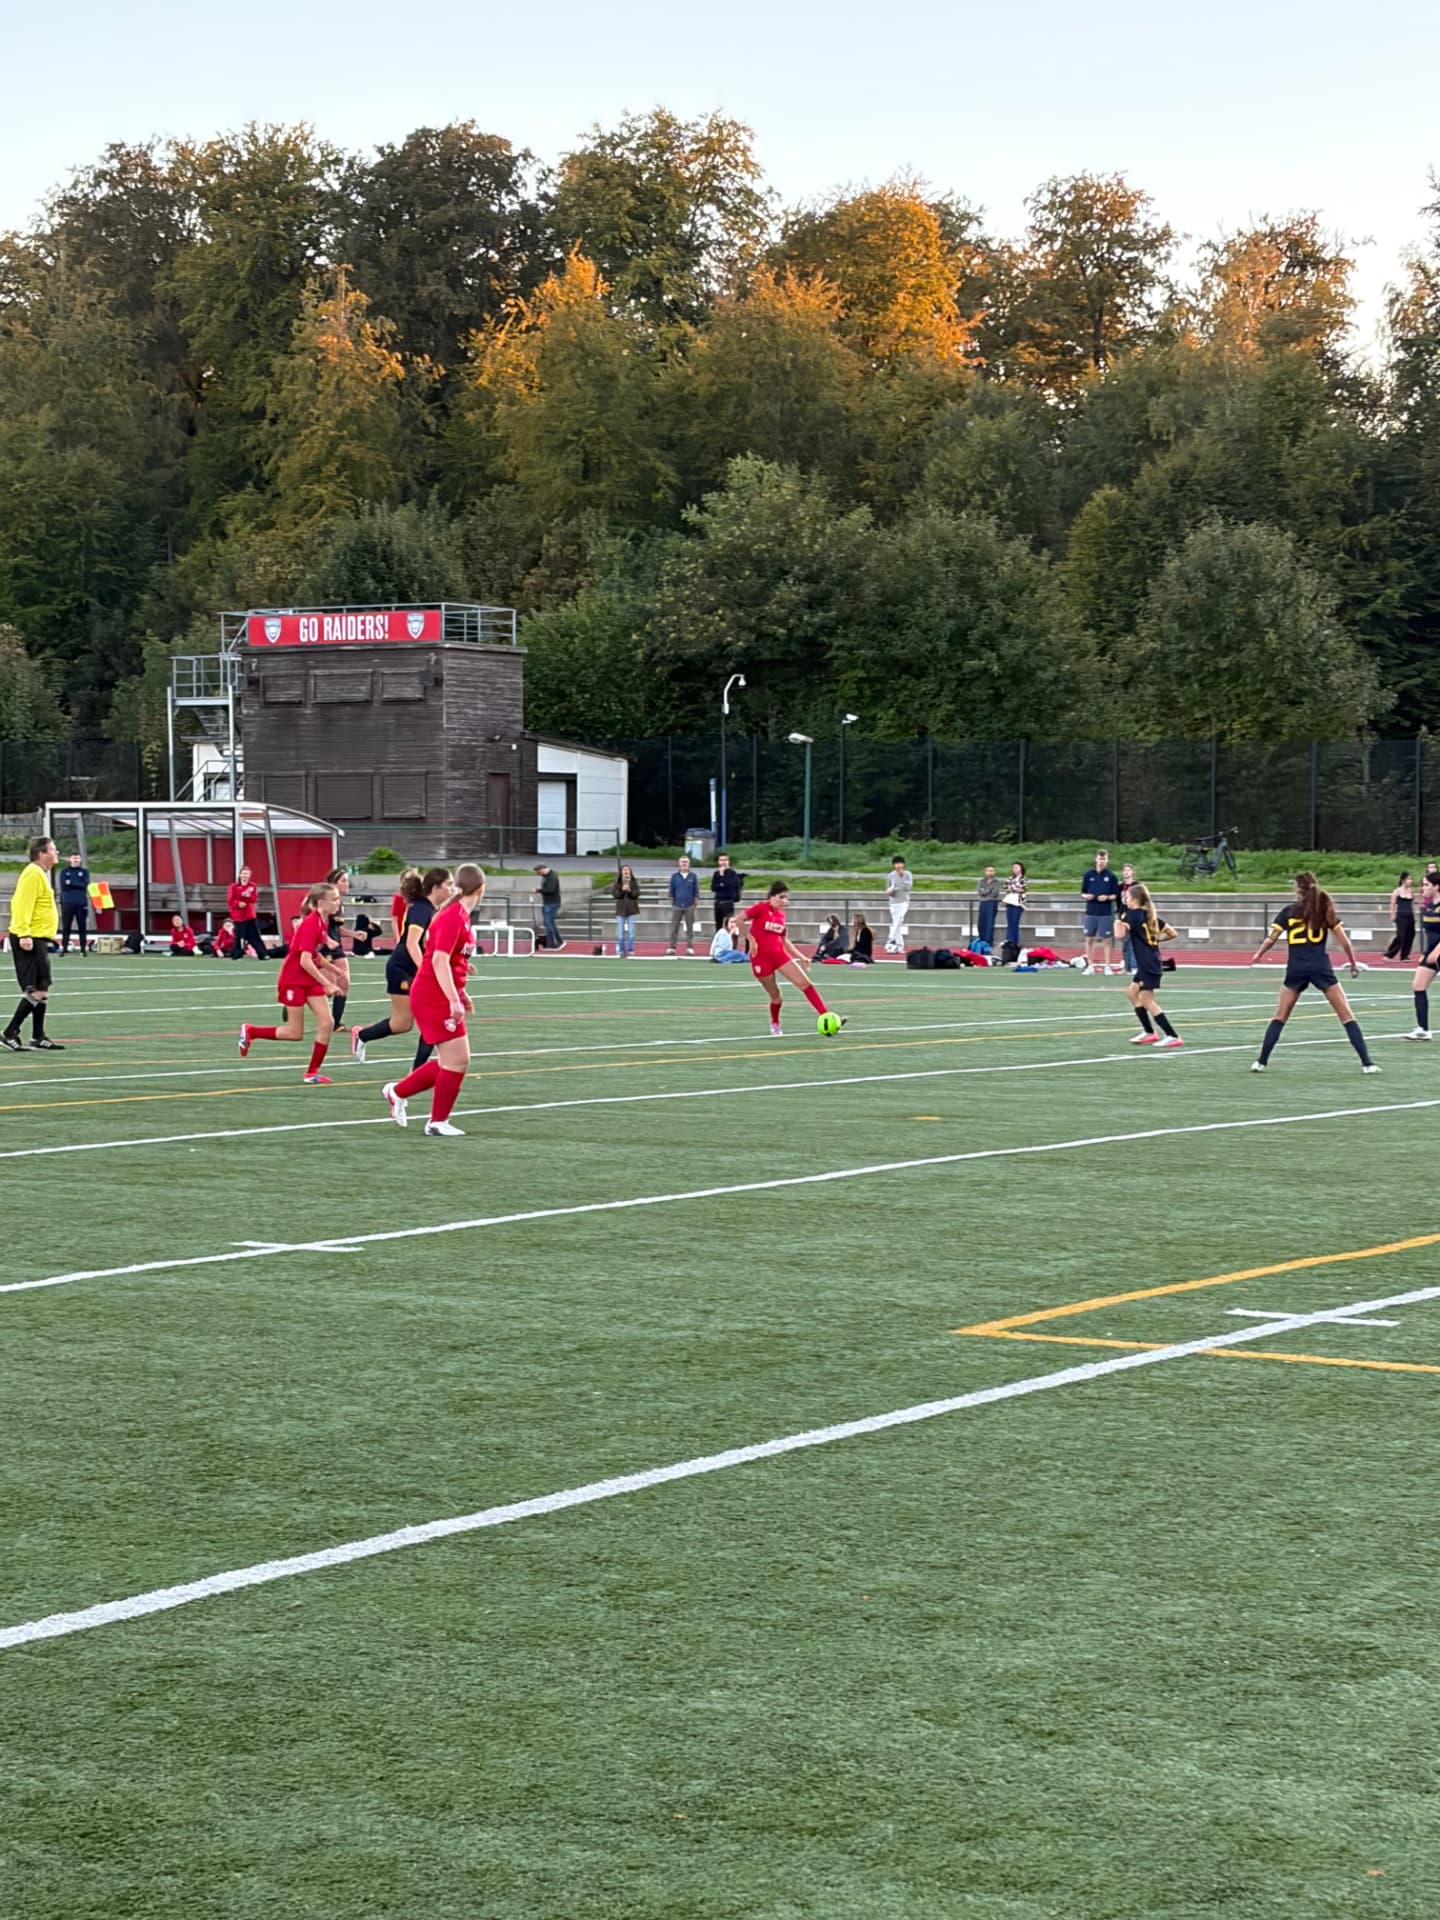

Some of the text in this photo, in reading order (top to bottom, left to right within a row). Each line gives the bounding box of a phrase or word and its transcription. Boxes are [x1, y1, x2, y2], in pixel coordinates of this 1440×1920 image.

[300, 614, 389, 642] GO RAIDERS!
[1288, 918, 1324, 945] 20
